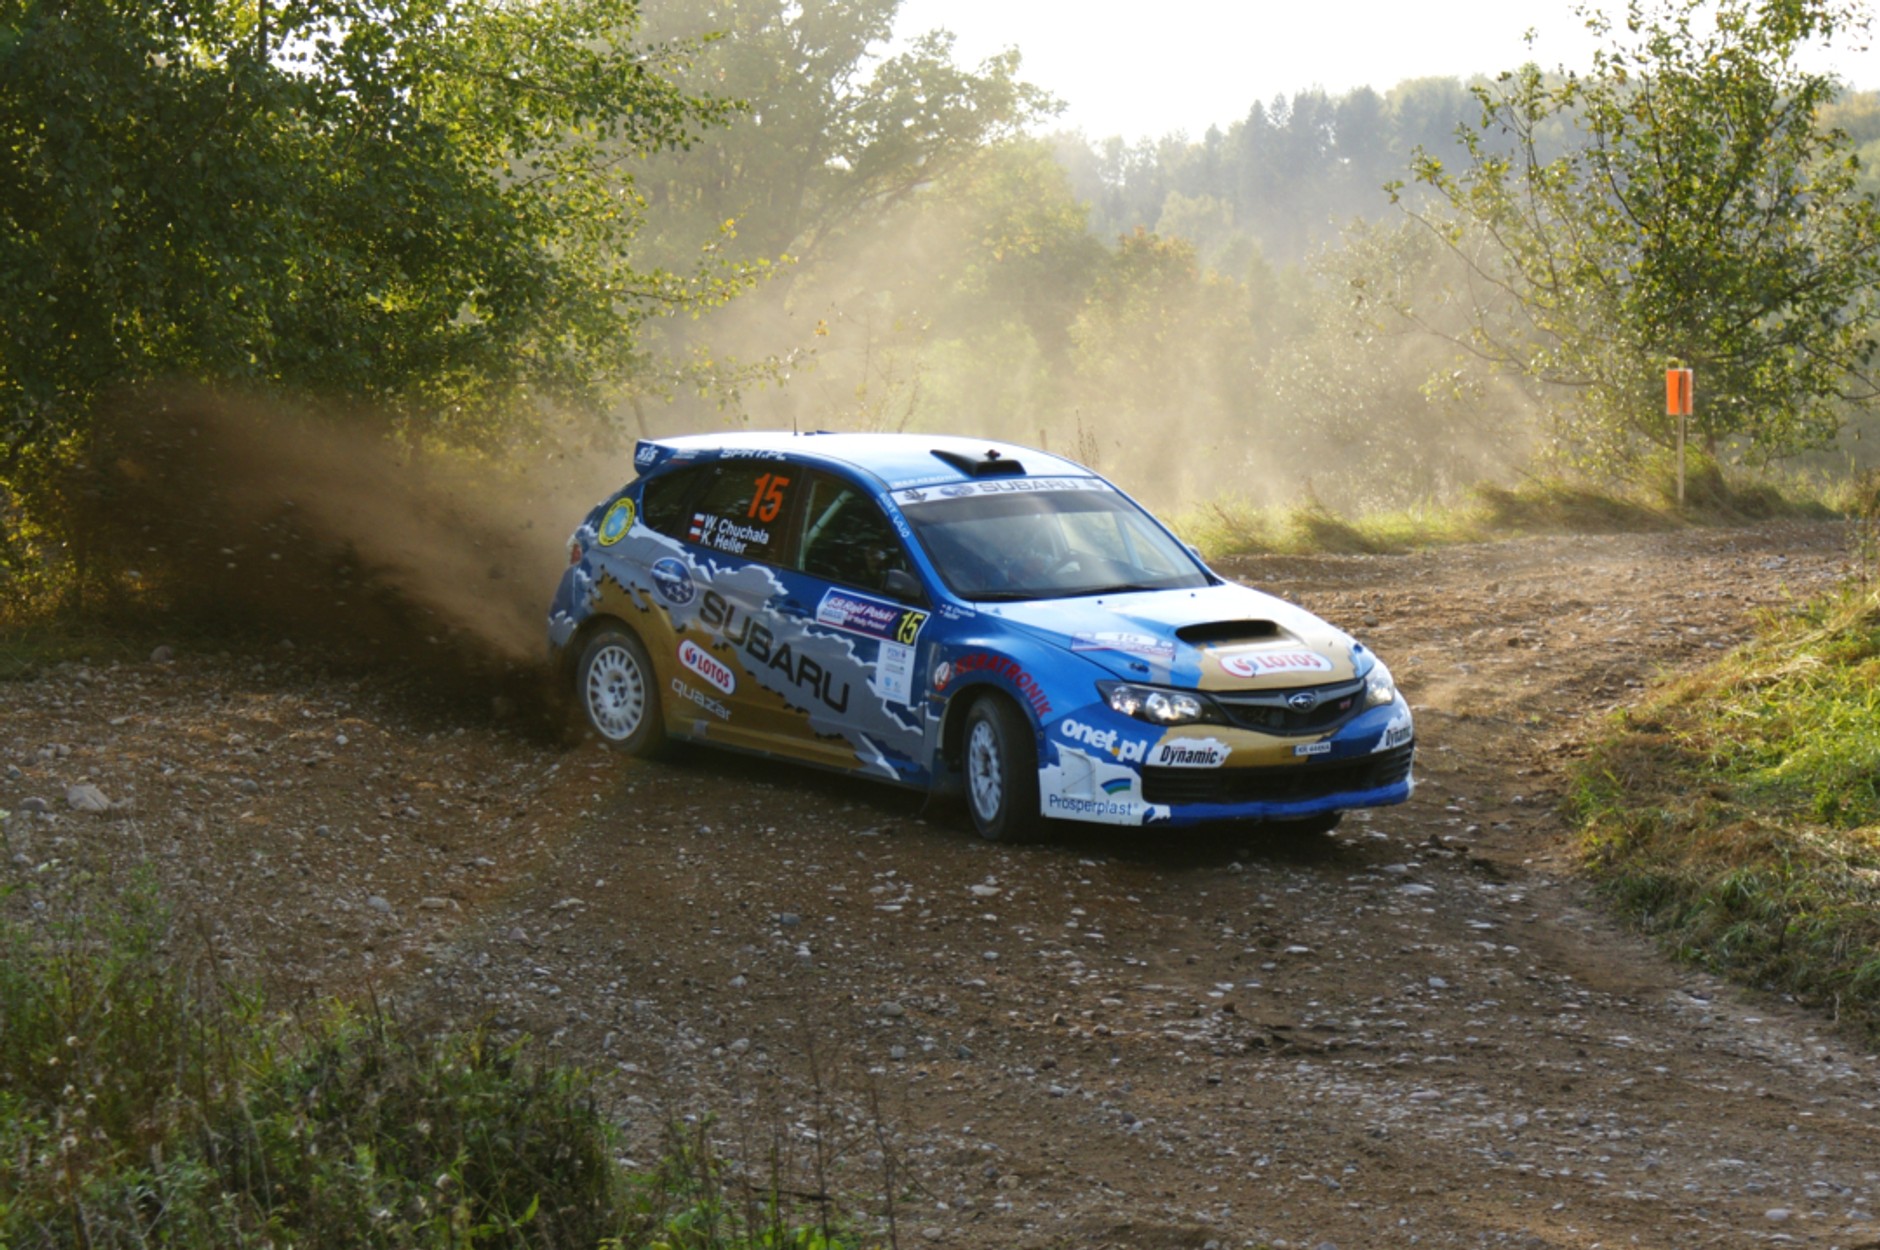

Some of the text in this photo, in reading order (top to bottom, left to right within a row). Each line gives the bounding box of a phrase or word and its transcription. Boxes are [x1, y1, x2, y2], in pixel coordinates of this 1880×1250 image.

[747, 473, 790, 523] 15
[978, 479, 1079, 492] SUBARU
[704, 514, 717, 531] W.
[700, 530, 748, 555] K. Heller
[898, 611, 925, 645] 15
[699, 590, 850, 714] SUBARU
[1256, 652, 1321, 669] LOTOS
[697, 653, 730, 689] LOTOS
[954, 653, 1053, 718] KERATRONIK
[1060, 718, 1148, 764] onet.pl
[1160, 745, 1219, 766] Dynamic
[1049, 793, 1132, 816] Prosperplast
